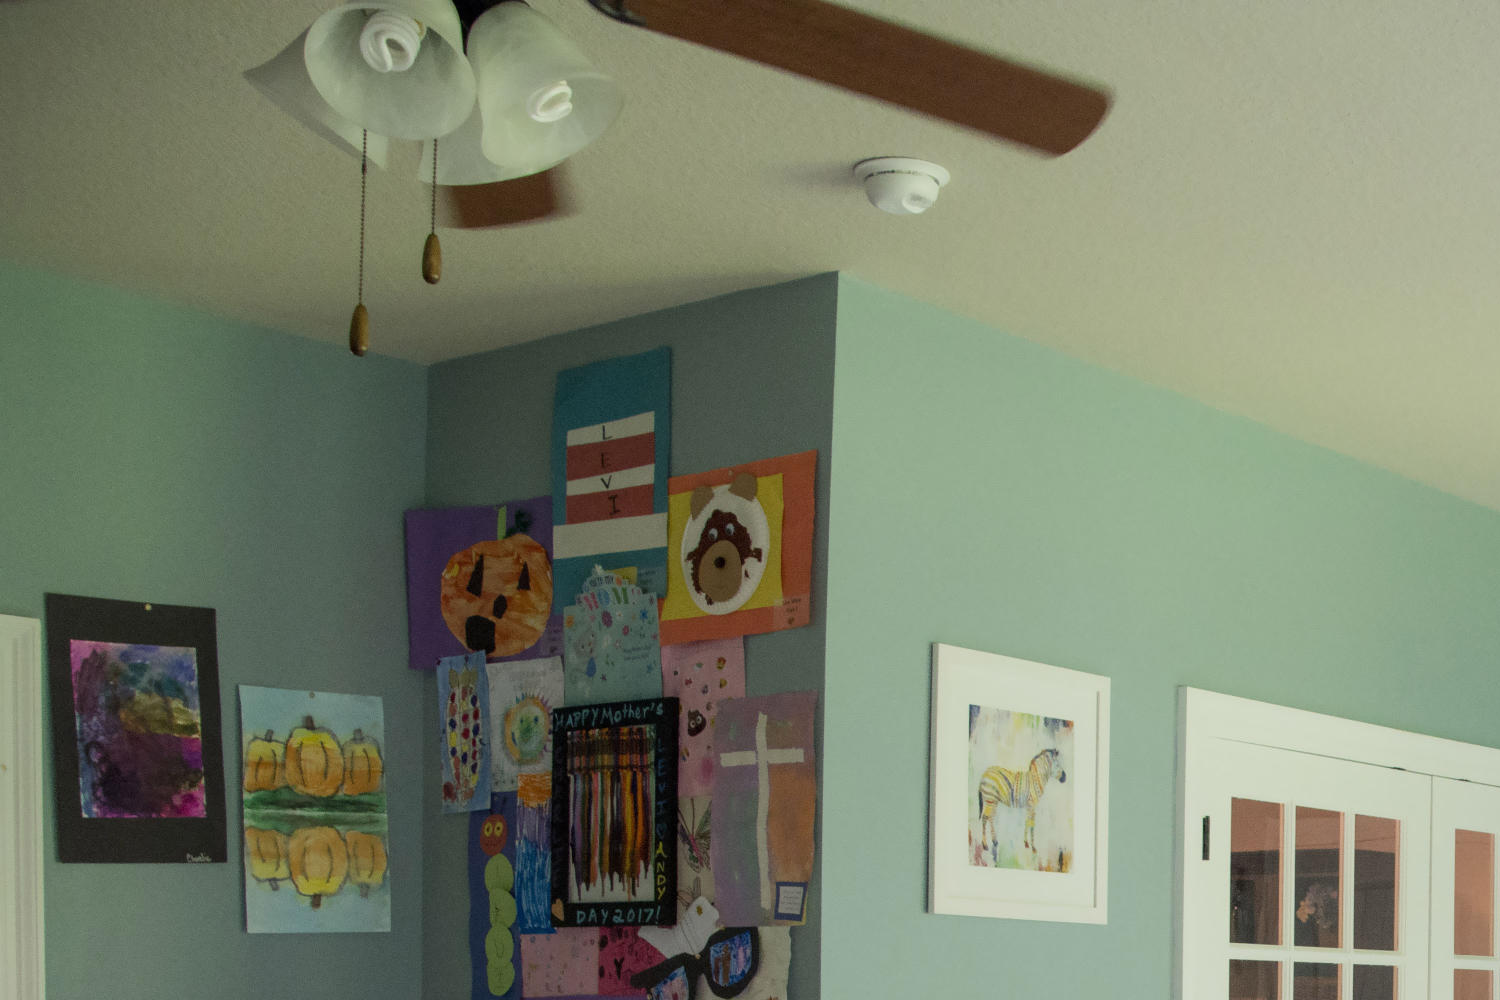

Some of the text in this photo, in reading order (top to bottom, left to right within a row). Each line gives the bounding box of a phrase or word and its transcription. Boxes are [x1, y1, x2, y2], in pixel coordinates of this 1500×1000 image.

[553, 701, 664, 732] HAPPY Mother's
[656, 841, 668, 901] ANDY
[575, 905, 662, 925] DAY 2017!
